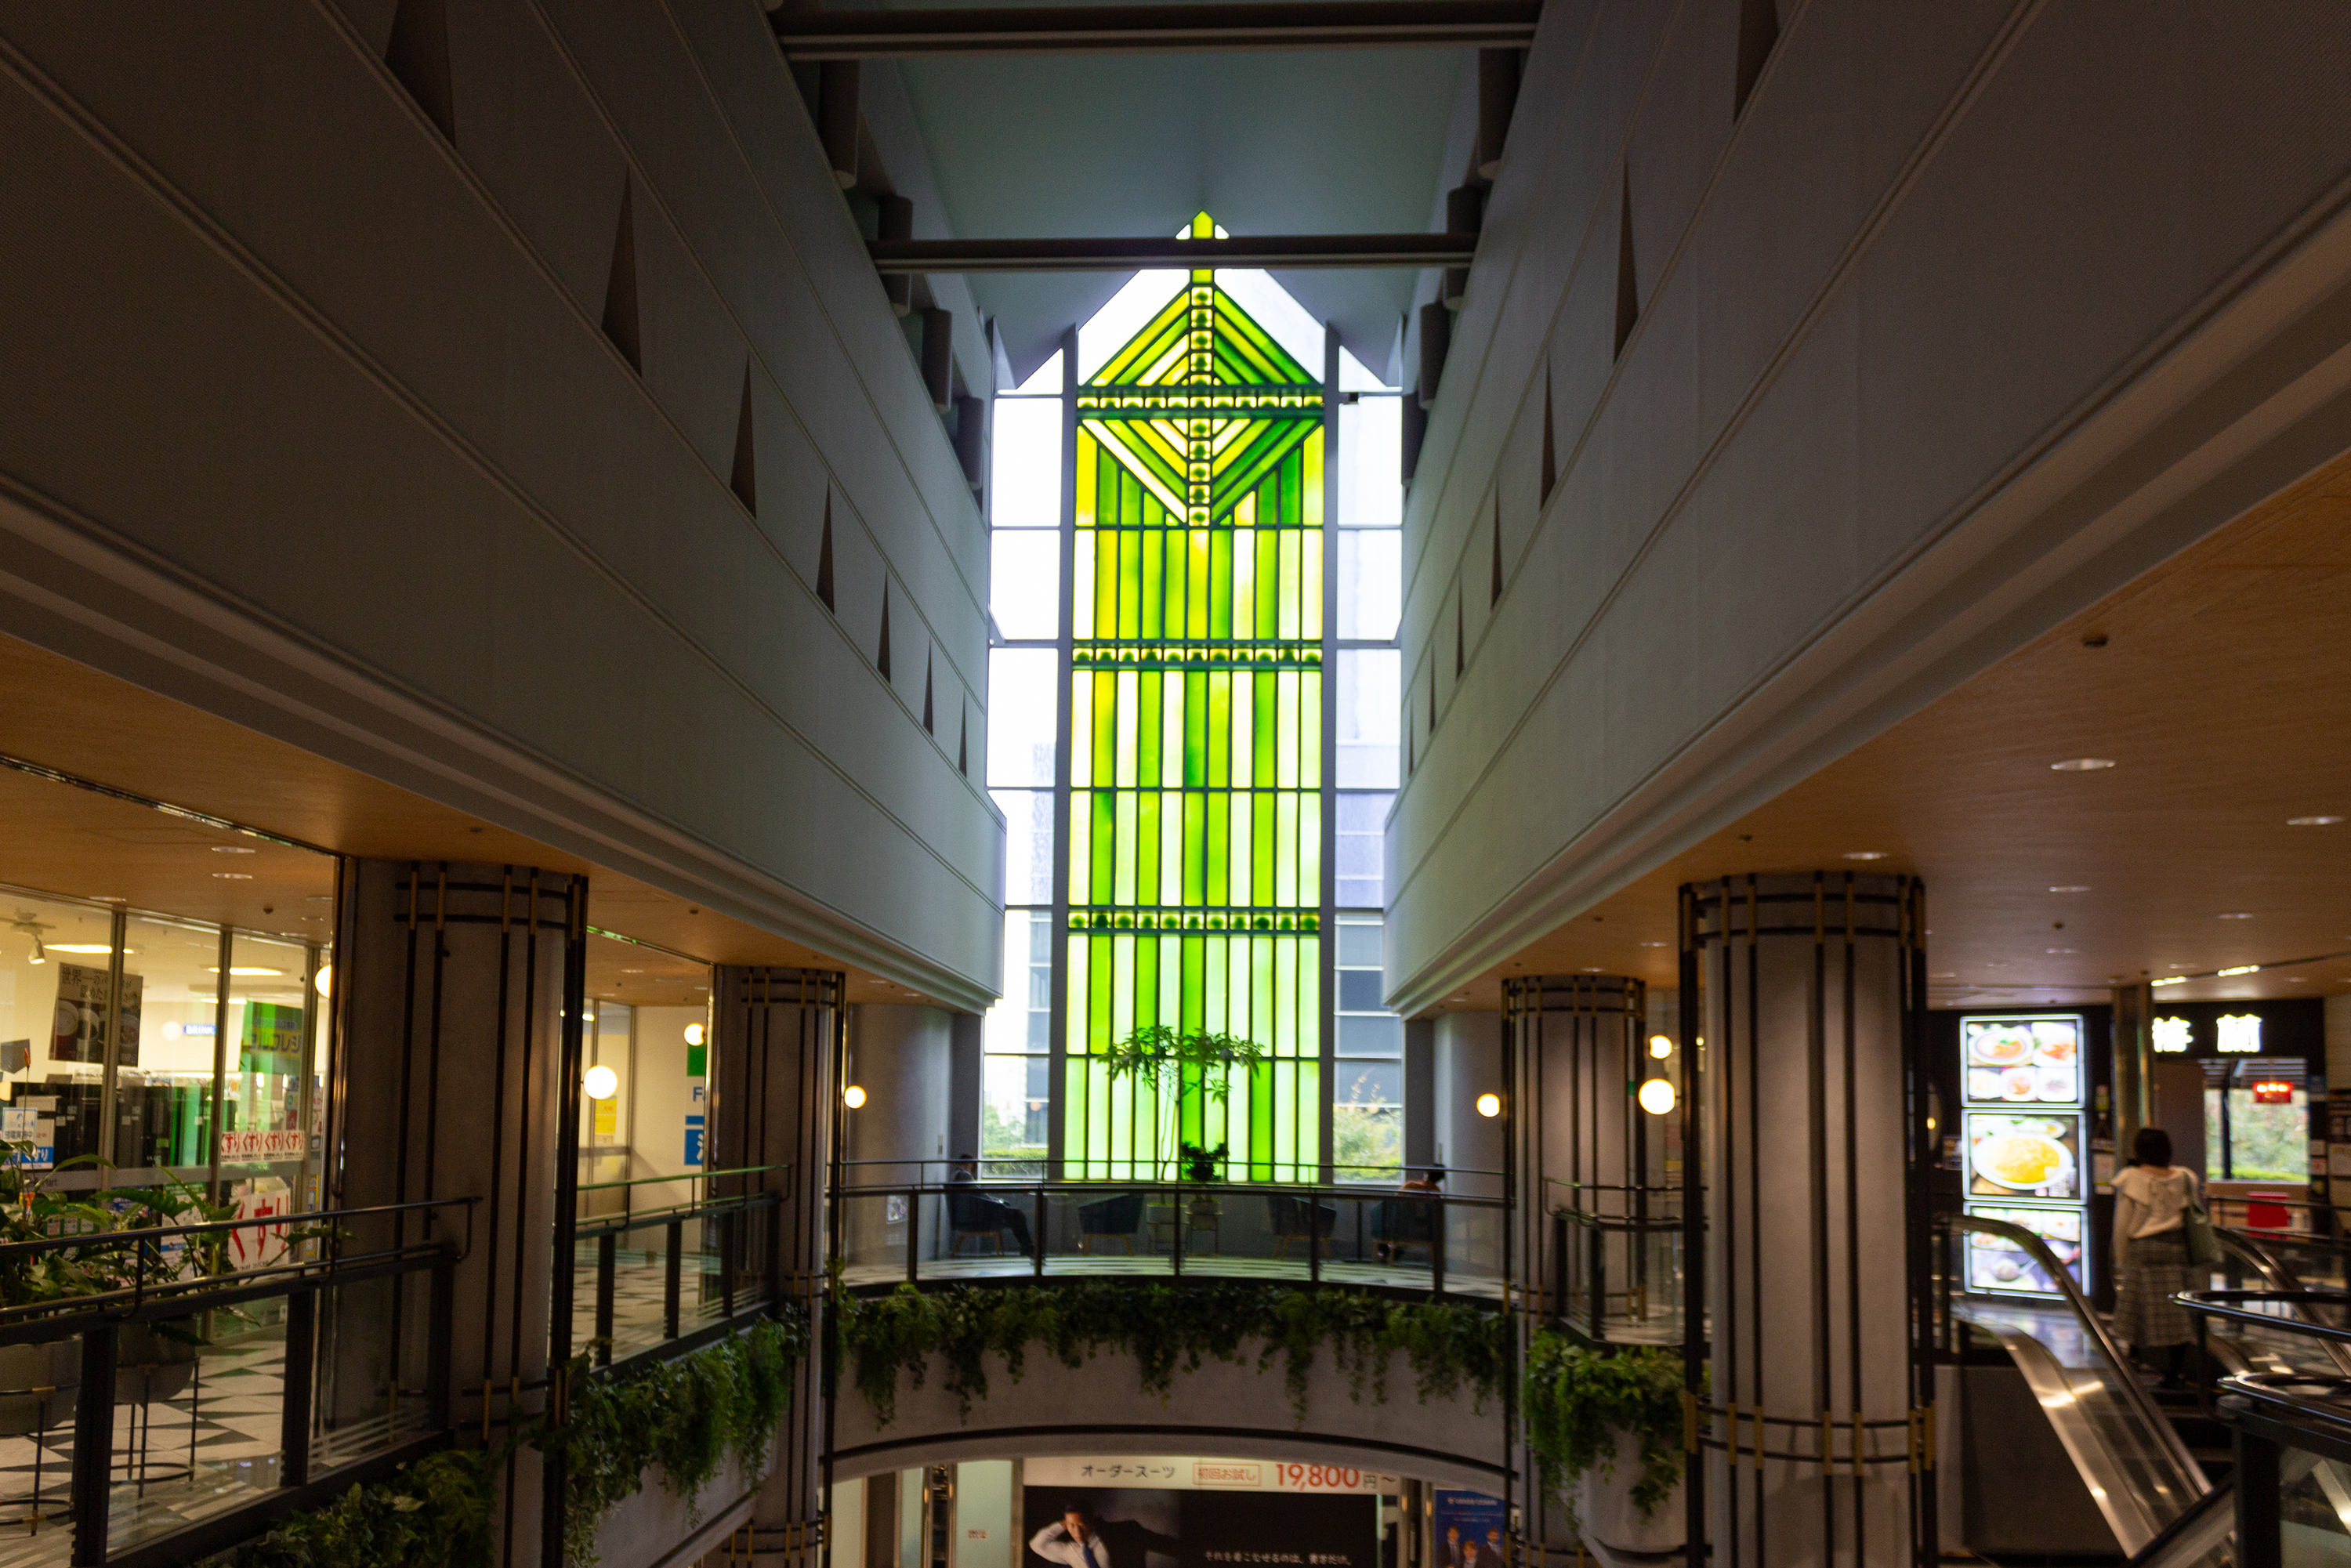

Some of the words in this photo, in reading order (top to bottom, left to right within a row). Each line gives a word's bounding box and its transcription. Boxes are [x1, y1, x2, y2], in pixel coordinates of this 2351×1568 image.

[186, 1025, 215, 1034] DRINK
[243, 1132, 263, 1152] くすり
[265, 1132, 284, 1151] くすり
[286, 1132, 303, 1150] くすり
[230, 1194, 289, 1263] くすり
[1081, 1465, 1176, 1479] オーダースーツ
[1197, 1467, 1257, 1481] 初回お試し
